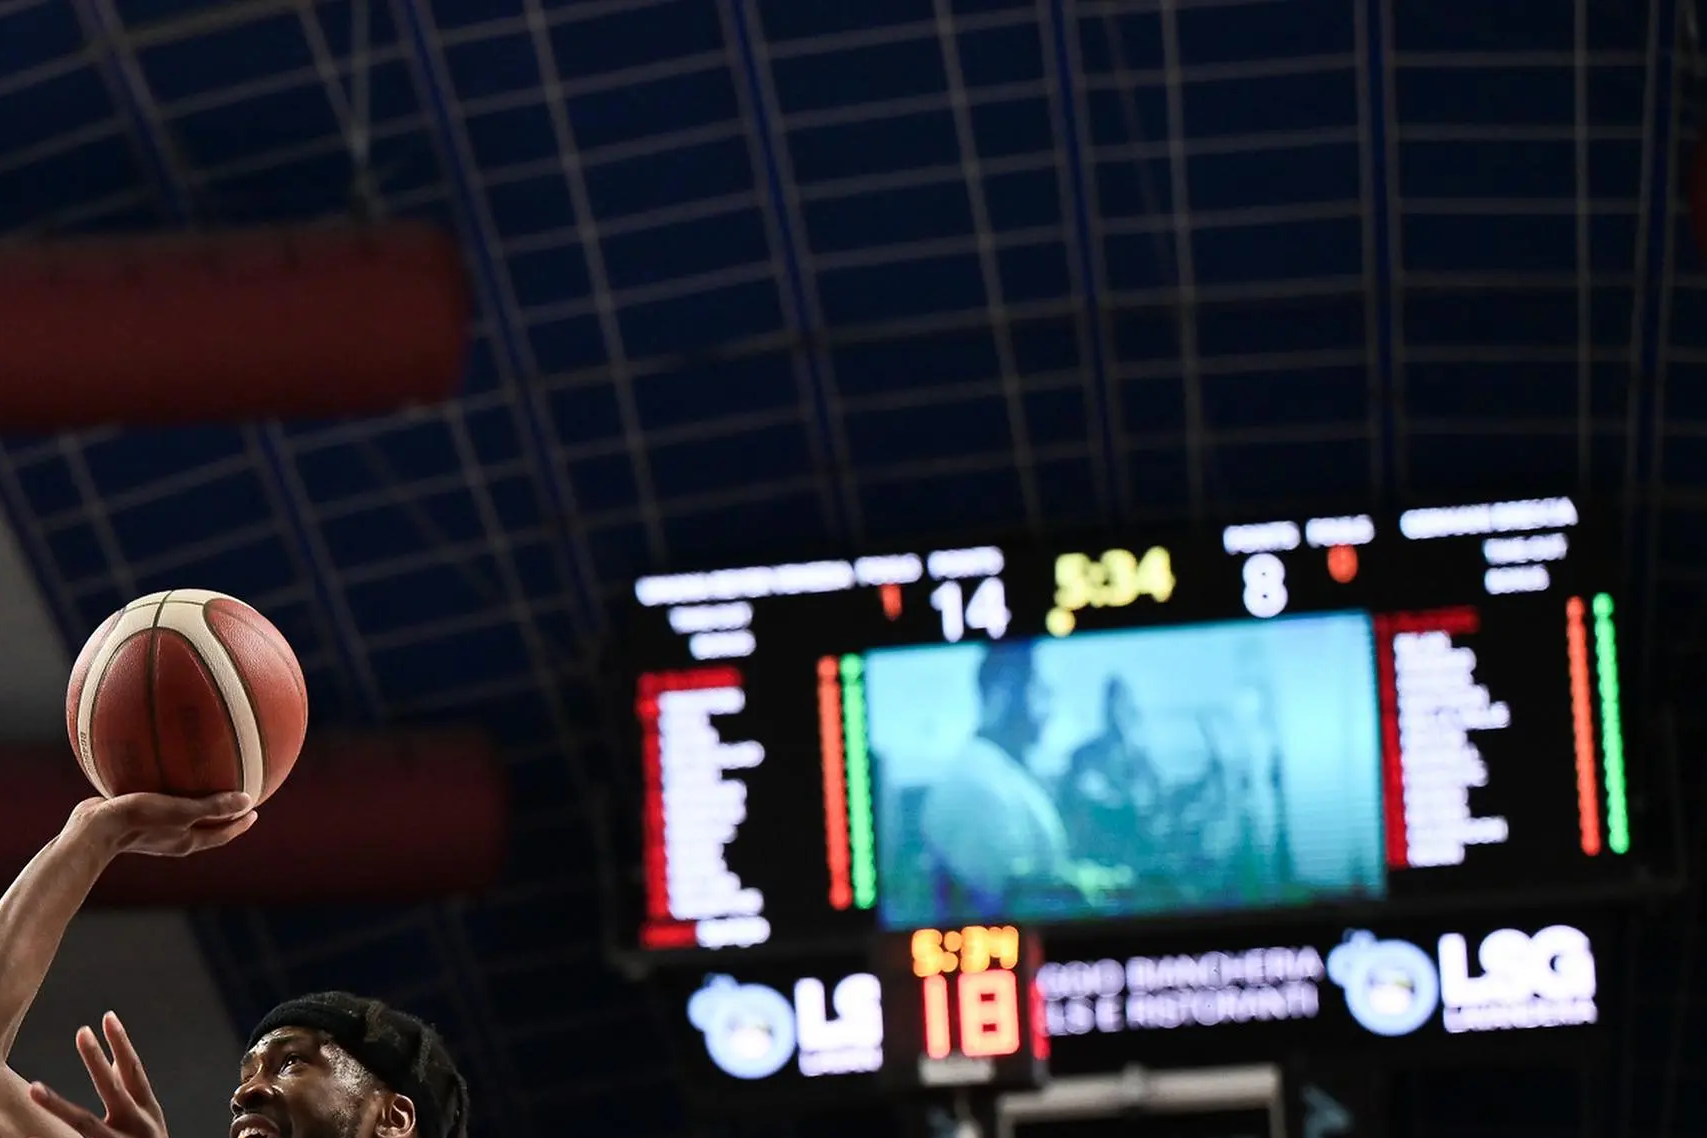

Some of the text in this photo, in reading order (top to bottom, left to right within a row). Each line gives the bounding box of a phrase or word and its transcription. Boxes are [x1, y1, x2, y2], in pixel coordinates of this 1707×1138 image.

[931, 577, 1011, 642] 14
[1242, 553, 1289, 618] 8
[923, 969, 1021, 1060] 18
